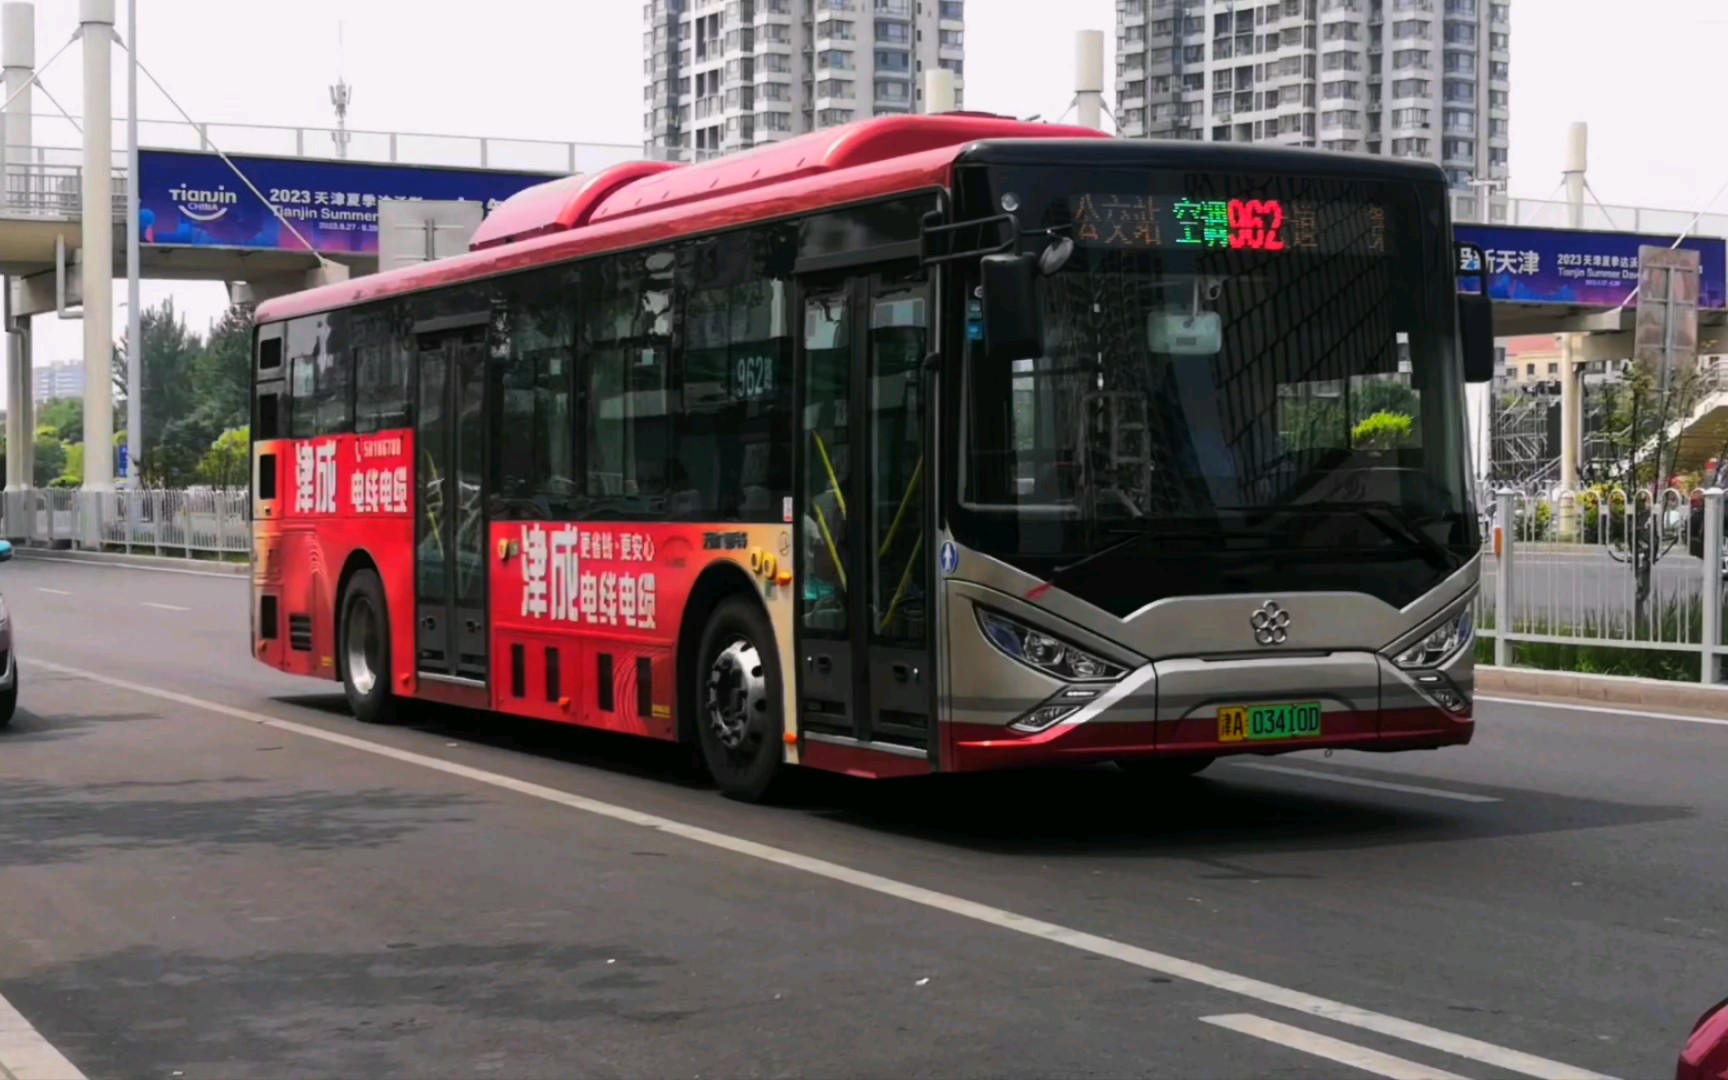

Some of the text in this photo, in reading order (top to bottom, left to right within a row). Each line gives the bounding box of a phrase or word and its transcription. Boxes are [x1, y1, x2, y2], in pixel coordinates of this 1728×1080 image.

[169, 183, 237, 204] Tianjin
[270, 189, 311, 204] 2023
[187, 203, 219, 211] CHINA
[272, 205, 380, 222] Tianjin Summer
[1228, 198, 1285, 251] 962
[1557, 253, 1582, 266] 2023
[1557, 267, 1585, 279] Tianjin
[1586, 268, 1620, 279] Summer
[295, 439, 337, 514] 津成
[351, 466, 408, 513] 电线电缆
[520, 522, 580, 622] 津成
[580, 570, 656, 630] 电线电缆
[1252, 706, 1320, 736] 03410D
